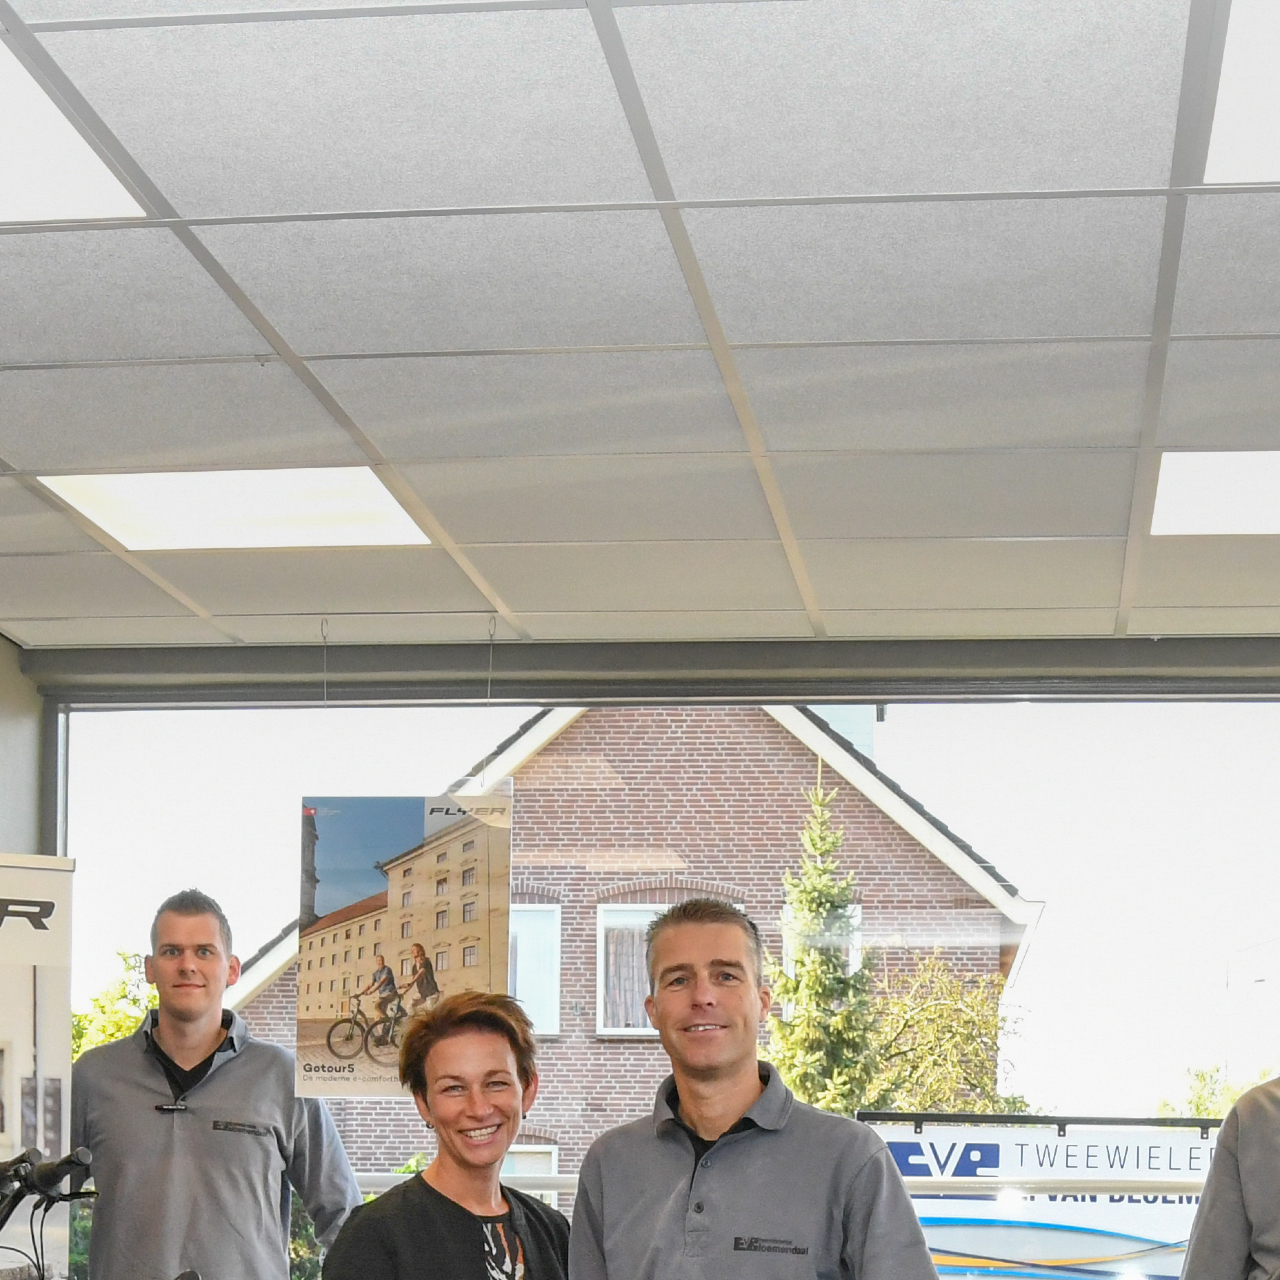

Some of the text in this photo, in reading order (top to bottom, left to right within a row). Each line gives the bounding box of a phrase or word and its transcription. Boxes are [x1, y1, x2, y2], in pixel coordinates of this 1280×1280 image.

[429, 807, 506, 816] FLYER
[303, 1063, 355, 1073] Gotour5
[1015, 1143, 1215, 1170] TWEEWIELE
